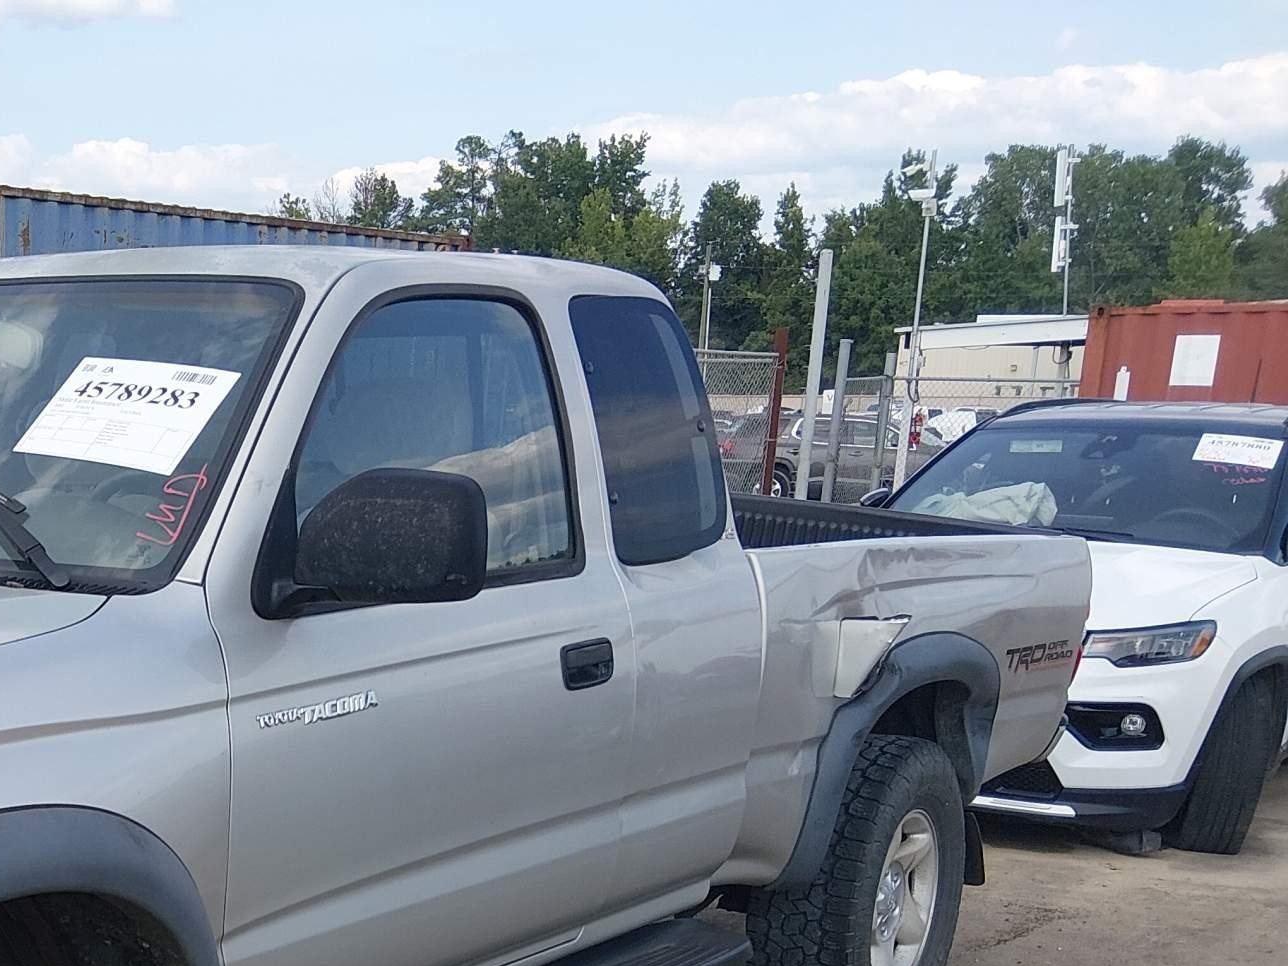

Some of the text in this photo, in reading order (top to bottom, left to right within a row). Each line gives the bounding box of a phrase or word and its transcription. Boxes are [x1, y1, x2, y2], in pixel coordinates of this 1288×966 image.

[73, 380, 200, 410] 45789283
[1006, 643, 1073, 674] TRD ROAD
[1047, 639, 1070, 651] OFF
[256, 689, 379, 729] TOYOTA TACOMA
